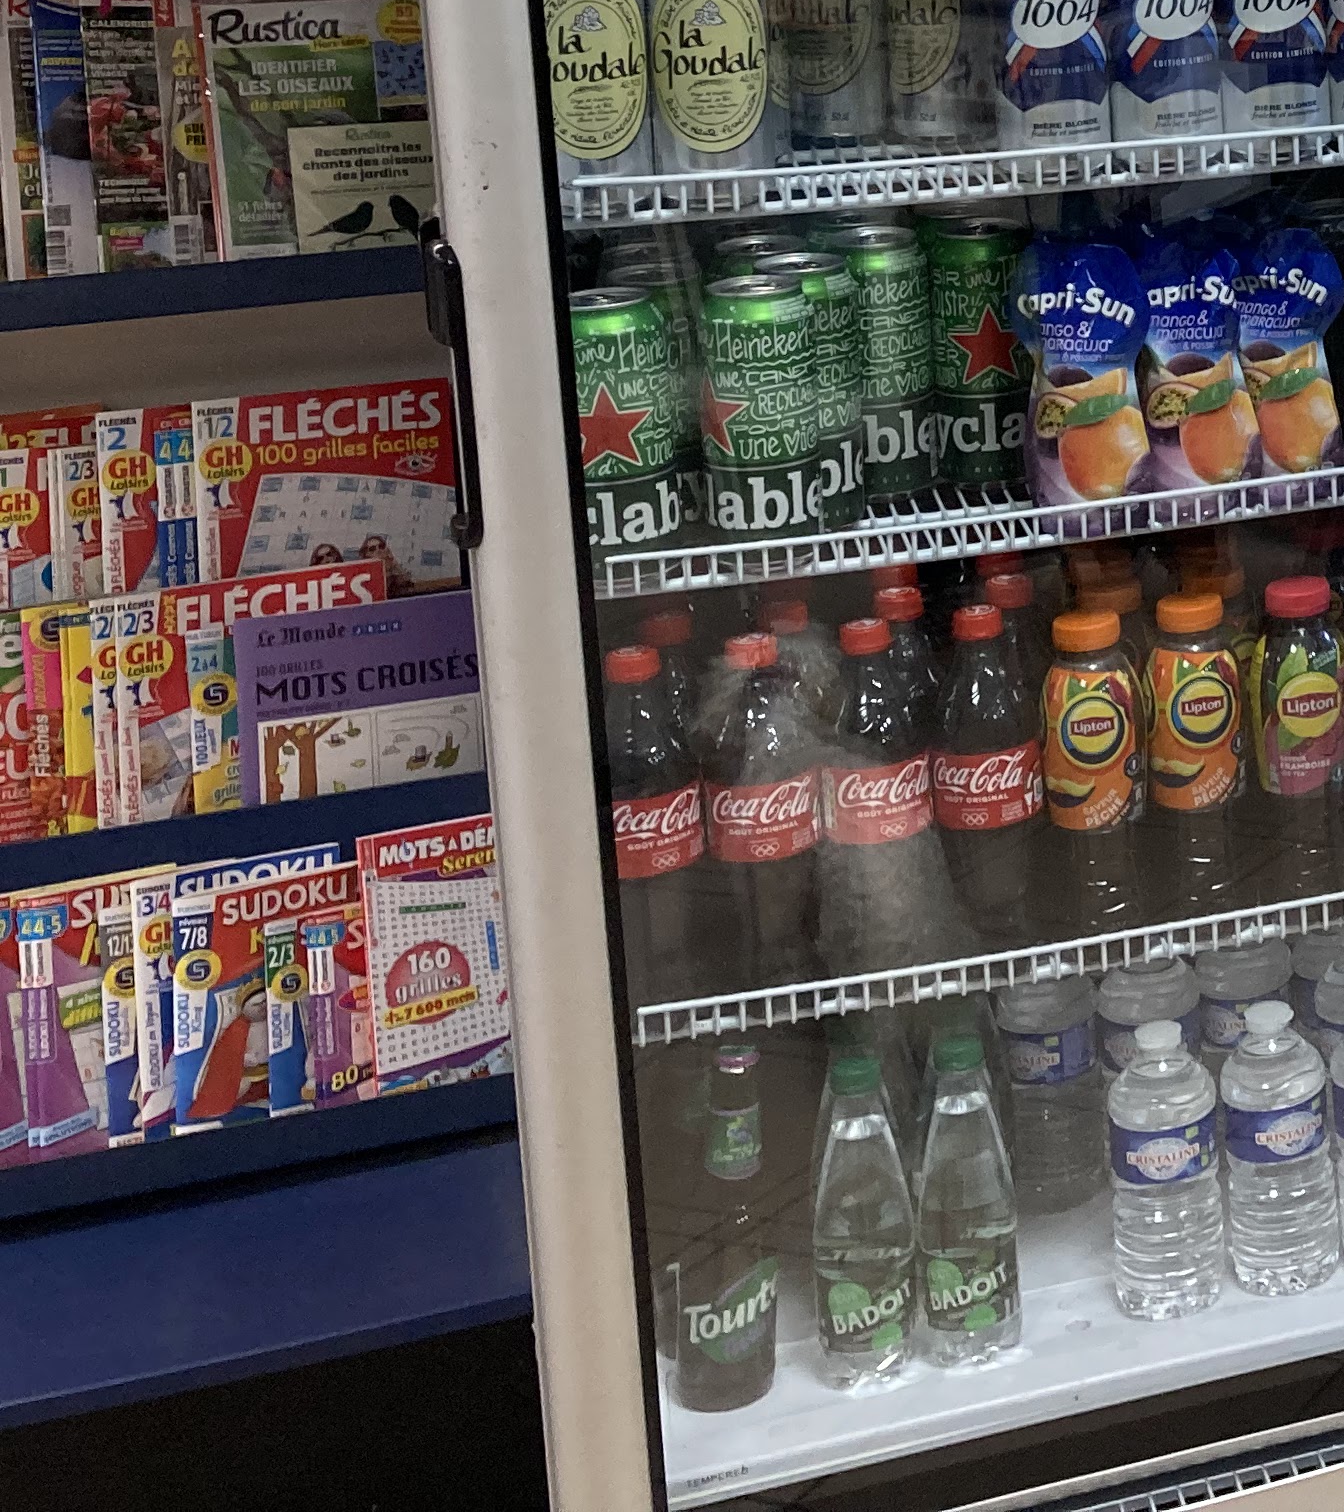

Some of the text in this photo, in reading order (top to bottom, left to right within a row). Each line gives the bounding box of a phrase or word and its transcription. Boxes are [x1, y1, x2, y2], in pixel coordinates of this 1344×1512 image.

[208, 9, 342, 45] Rustica
[251, 58, 337, 76] IDENTIFIER
[653, 31, 766, 90] Goudale
[238, 76, 354, 97] LES OISEAUX
[715, 320, 810, 362] Heineken
[248, 392, 442, 445] FLÉCHÉS
[256, 431, 439, 470] 100 grilles faciles
[125, 641, 165, 665] GH
[256, 649, 479, 705] MOTS CROISÉS
[1286, 695, 1335, 715] Lipton
[1074, 719, 1113, 735] Lipton
[933, 749, 1026, 794] Coca-Cola
[713, 776, 810, 824] Coca-Cola
[222, 874, 347, 926] SUDOKU
[408, 947, 451, 975] 160
[1126, 1144, 1200, 1166] CRISTALINE
[833, 1278, 911, 1335] BADOIT
